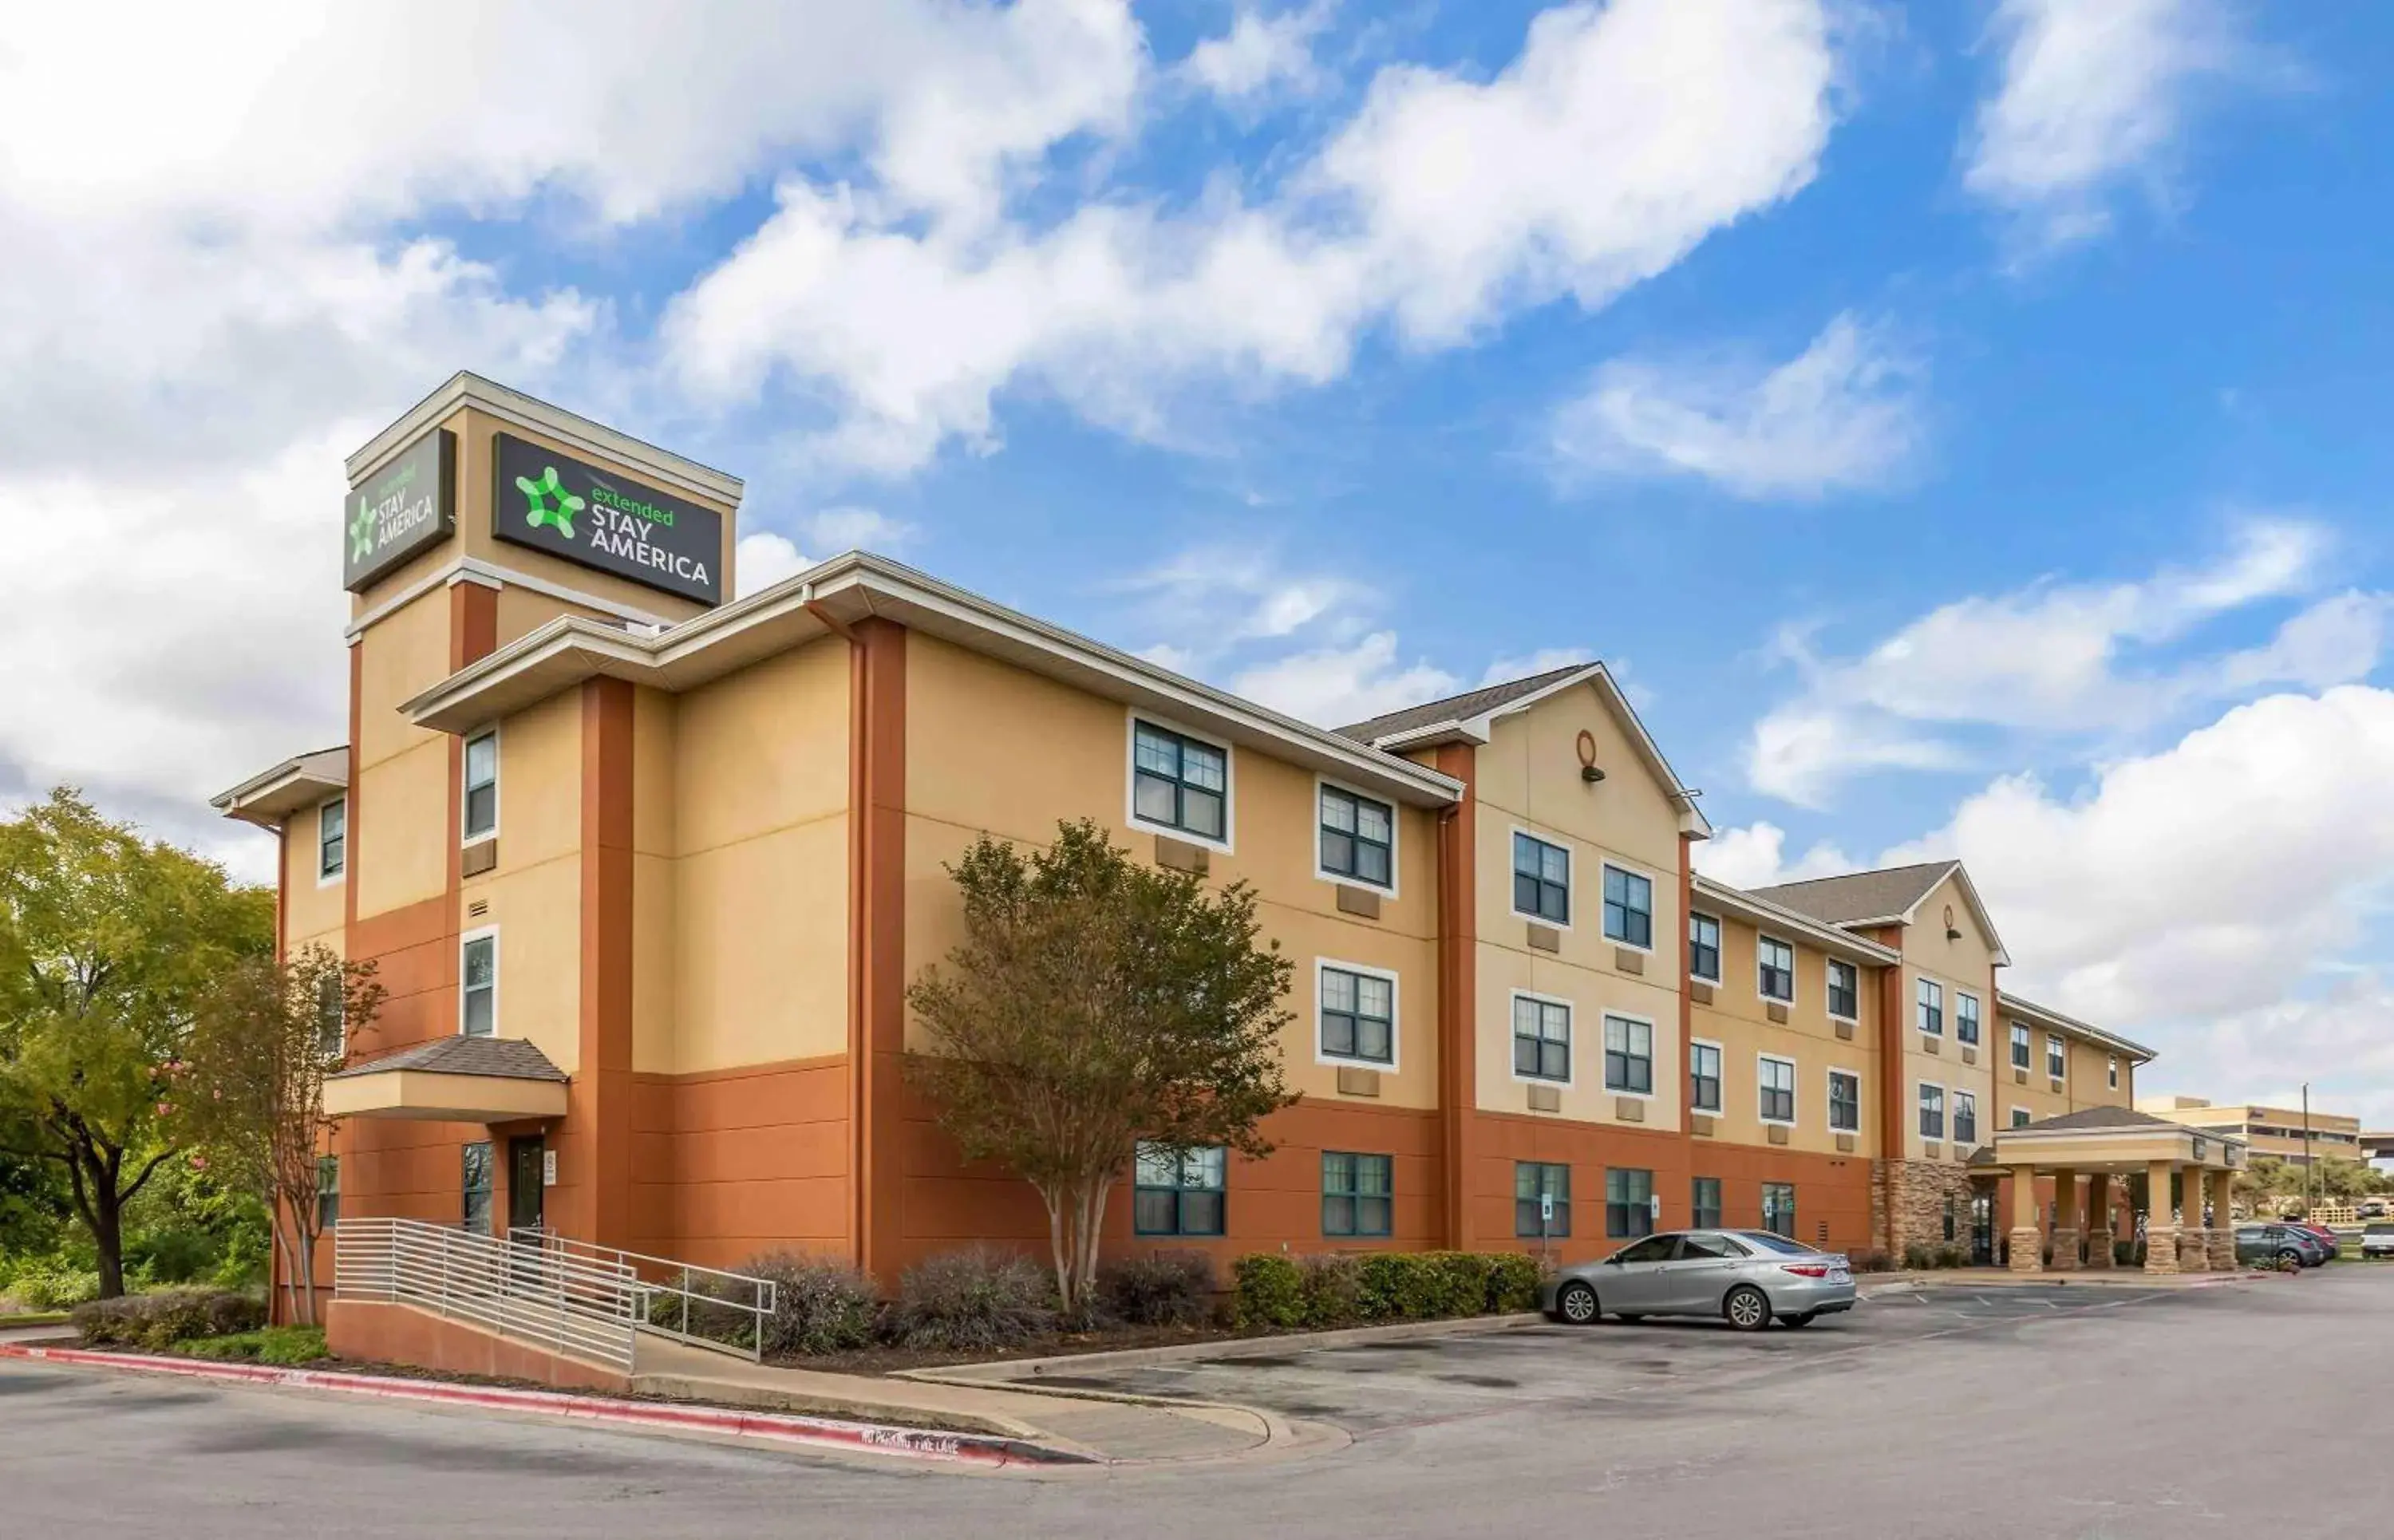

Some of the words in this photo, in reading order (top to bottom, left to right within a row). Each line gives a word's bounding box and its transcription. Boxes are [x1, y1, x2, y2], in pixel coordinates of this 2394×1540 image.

[377, 495, 433, 550] AMERICA
[379, 486, 406, 525] STAY
[591, 503, 653, 541] STAY
[592, 488, 674, 527] extended
[591, 527, 709, 586] AMERICA
